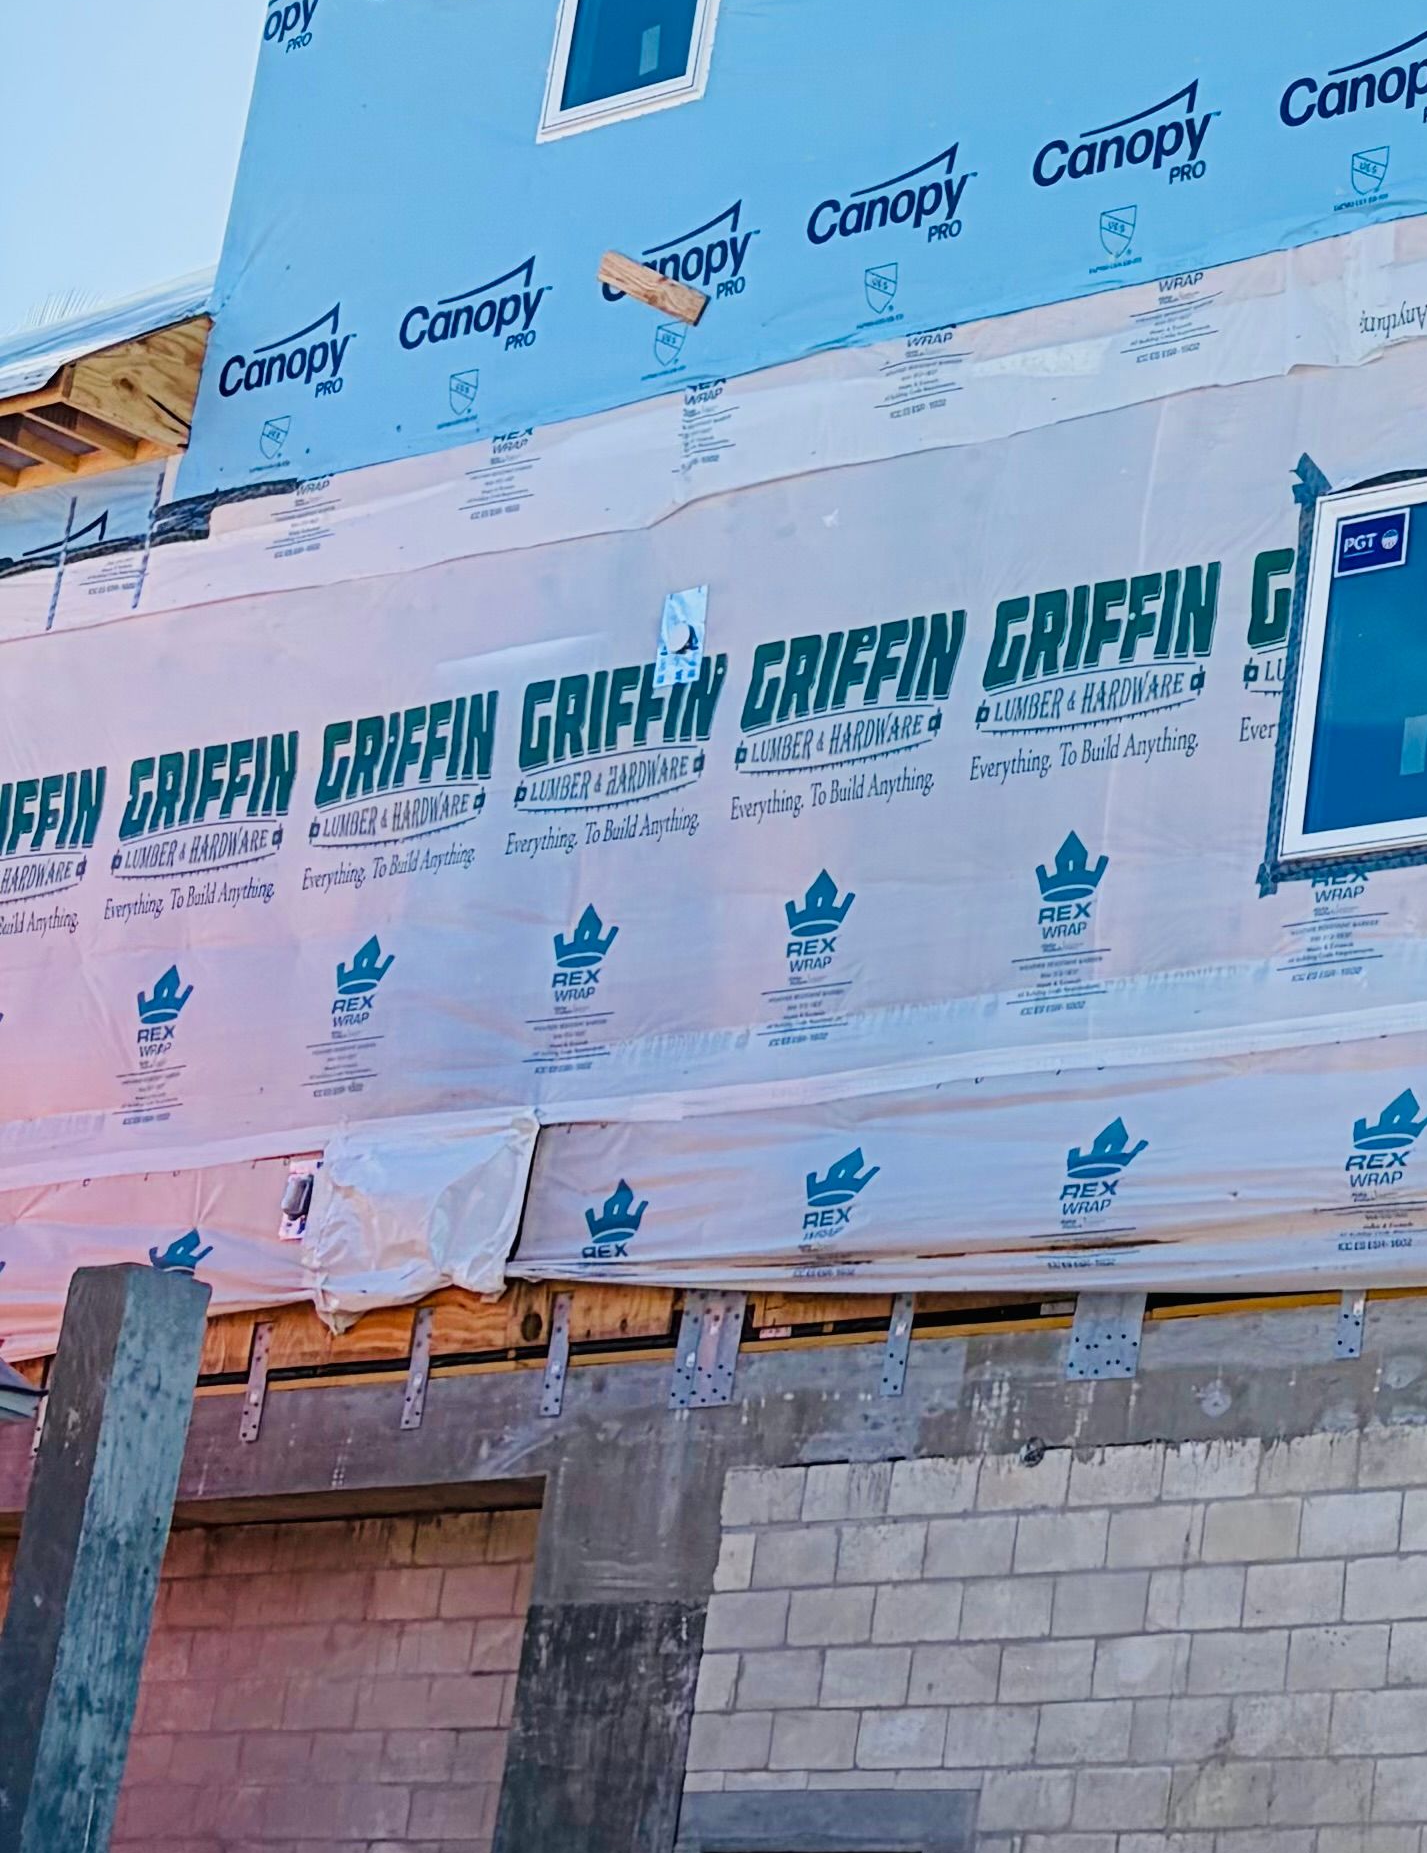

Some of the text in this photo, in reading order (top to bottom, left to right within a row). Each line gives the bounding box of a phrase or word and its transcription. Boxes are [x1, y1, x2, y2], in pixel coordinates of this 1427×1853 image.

[1031, 111, 1211, 188] Canopy
[1169, 160, 1206, 184] PRO
[806, 172, 968, 246] Canopy
[927, 219, 963, 242] PRO
[601, 234, 751, 303] Cnopy
[716, 275, 745, 300] PRO
[399, 286, 545, 351] Canopy
[505, 329, 536, 351] PRO
[219, 335, 348, 398] Canopy
[314, 377, 343, 398] PRO
[1344, 533, 1376, 553] PGT
[982, 561, 1222, 692] GRIFFIN
[740, 609, 967, 733] GRIFFIN
[995, 671, 1184, 724] LUMBER HARDWARE
[315, 689, 499, 809] GRIFFIN
[751, 712, 923, 765] LUMBER HARDWARE
[970, 729, 1199, 784] Everything. Build Anything.
[119, 730, 300, 840] GRIFFIN
[530, 753, 689, 802] LUMBER HARDWARE
[0, 766, 107, 849] IFFIN
[730, 769, 935, 822] Everything. Anything.
[323, 792, 469, 838] LUMBER HARDWARE
[125, 826, 268, 869] LUMBER HARDWARE
[506, 825, 579, 856] Everything.
[302, 861, 365, 891] Everything.
[1314, 884, 1364, 902] WRAP
[1039, 904, 1091, 925] REX
[1041, 920, 1087, 939] WRAP
[787, 936, 836, 958] REX
[789, 955, 832, 972] WRAP
[552, 969, 600, 987] REX
[332, 994, 374, 1013] REX
[554, 986, 596, 1002] WRAP
[137, 1025, 176, 1042] REX
[1345, 1151, 1408, 1171] REX
[1060, 1179, 1119, 1199] REX
[1349, 1169, 1403, 1188] WRAP
[802, 1207, 851, 1228] REX
[1062, 1197, 1112, 1215] WRAP
